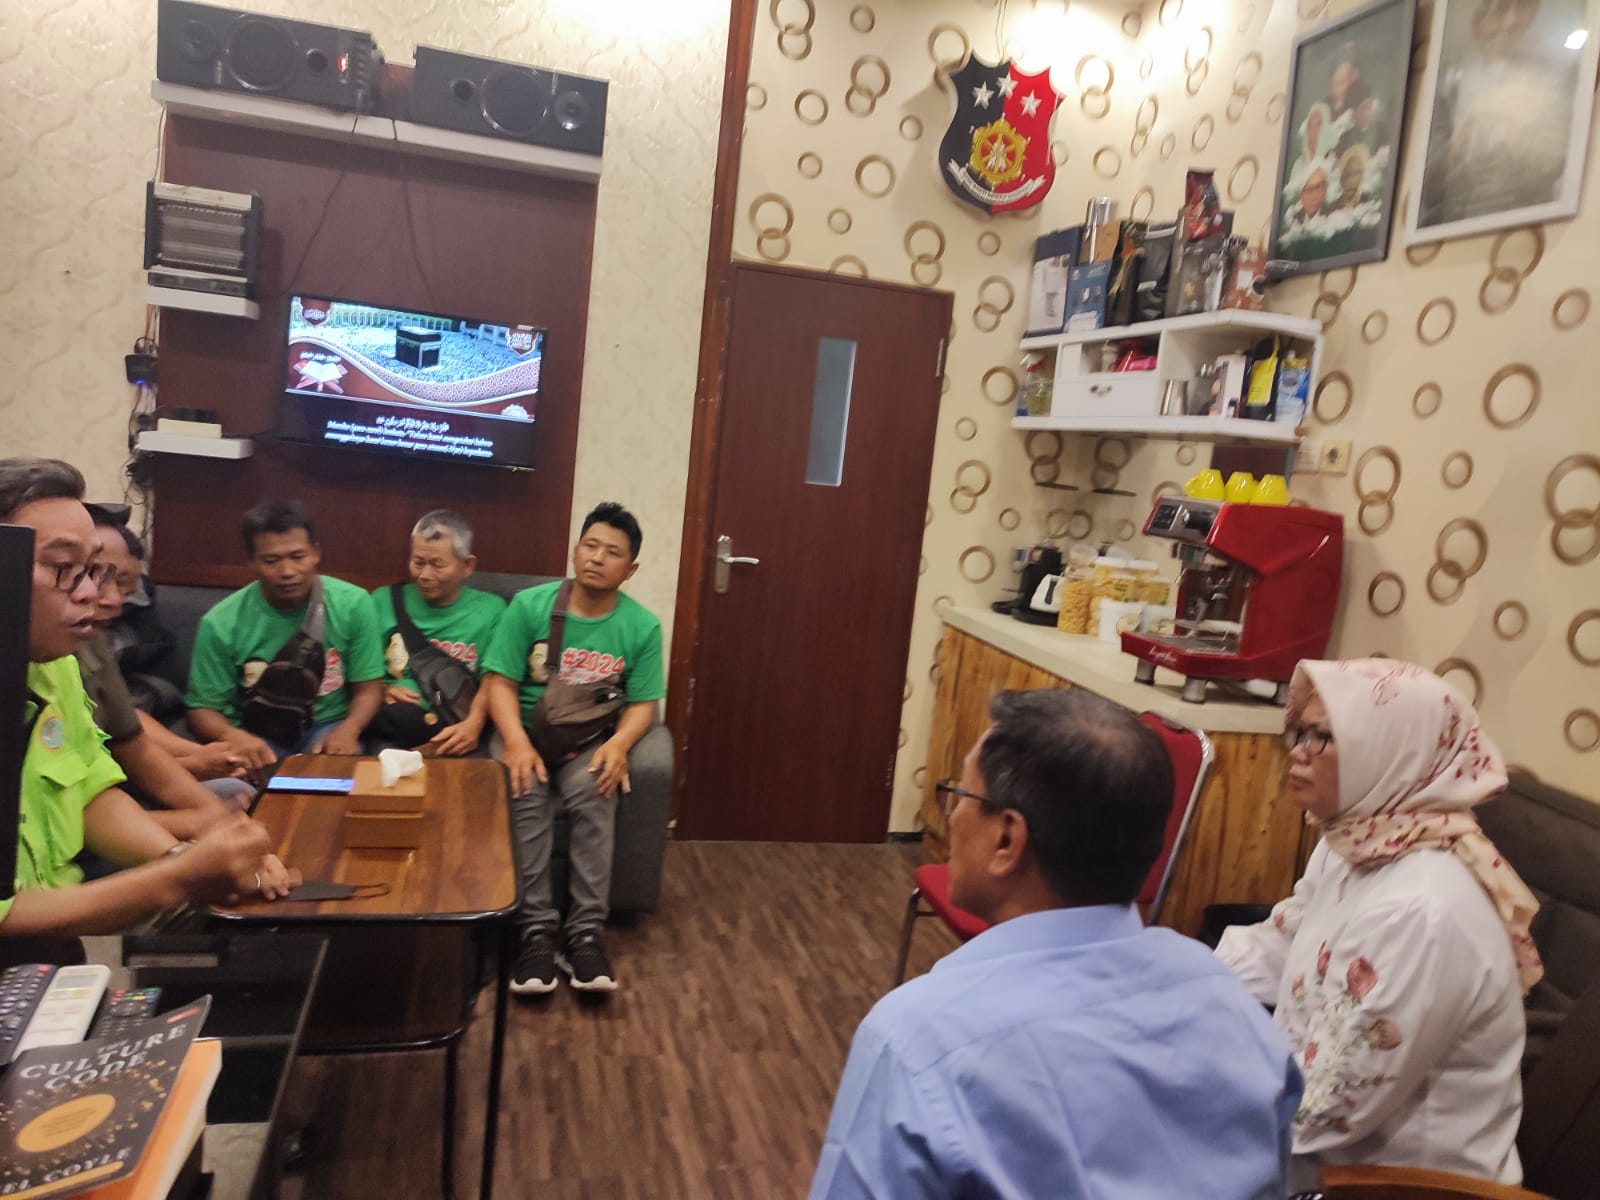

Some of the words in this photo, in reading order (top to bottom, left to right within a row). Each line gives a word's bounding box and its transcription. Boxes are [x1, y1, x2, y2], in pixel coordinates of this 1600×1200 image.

[561, 648, 625, 674] #2024
[20, 1024, 187, 1079] CULTURE
[45, 1051, 147, 1090] CODE
[43, 1146, 132, 1182] COYLE
